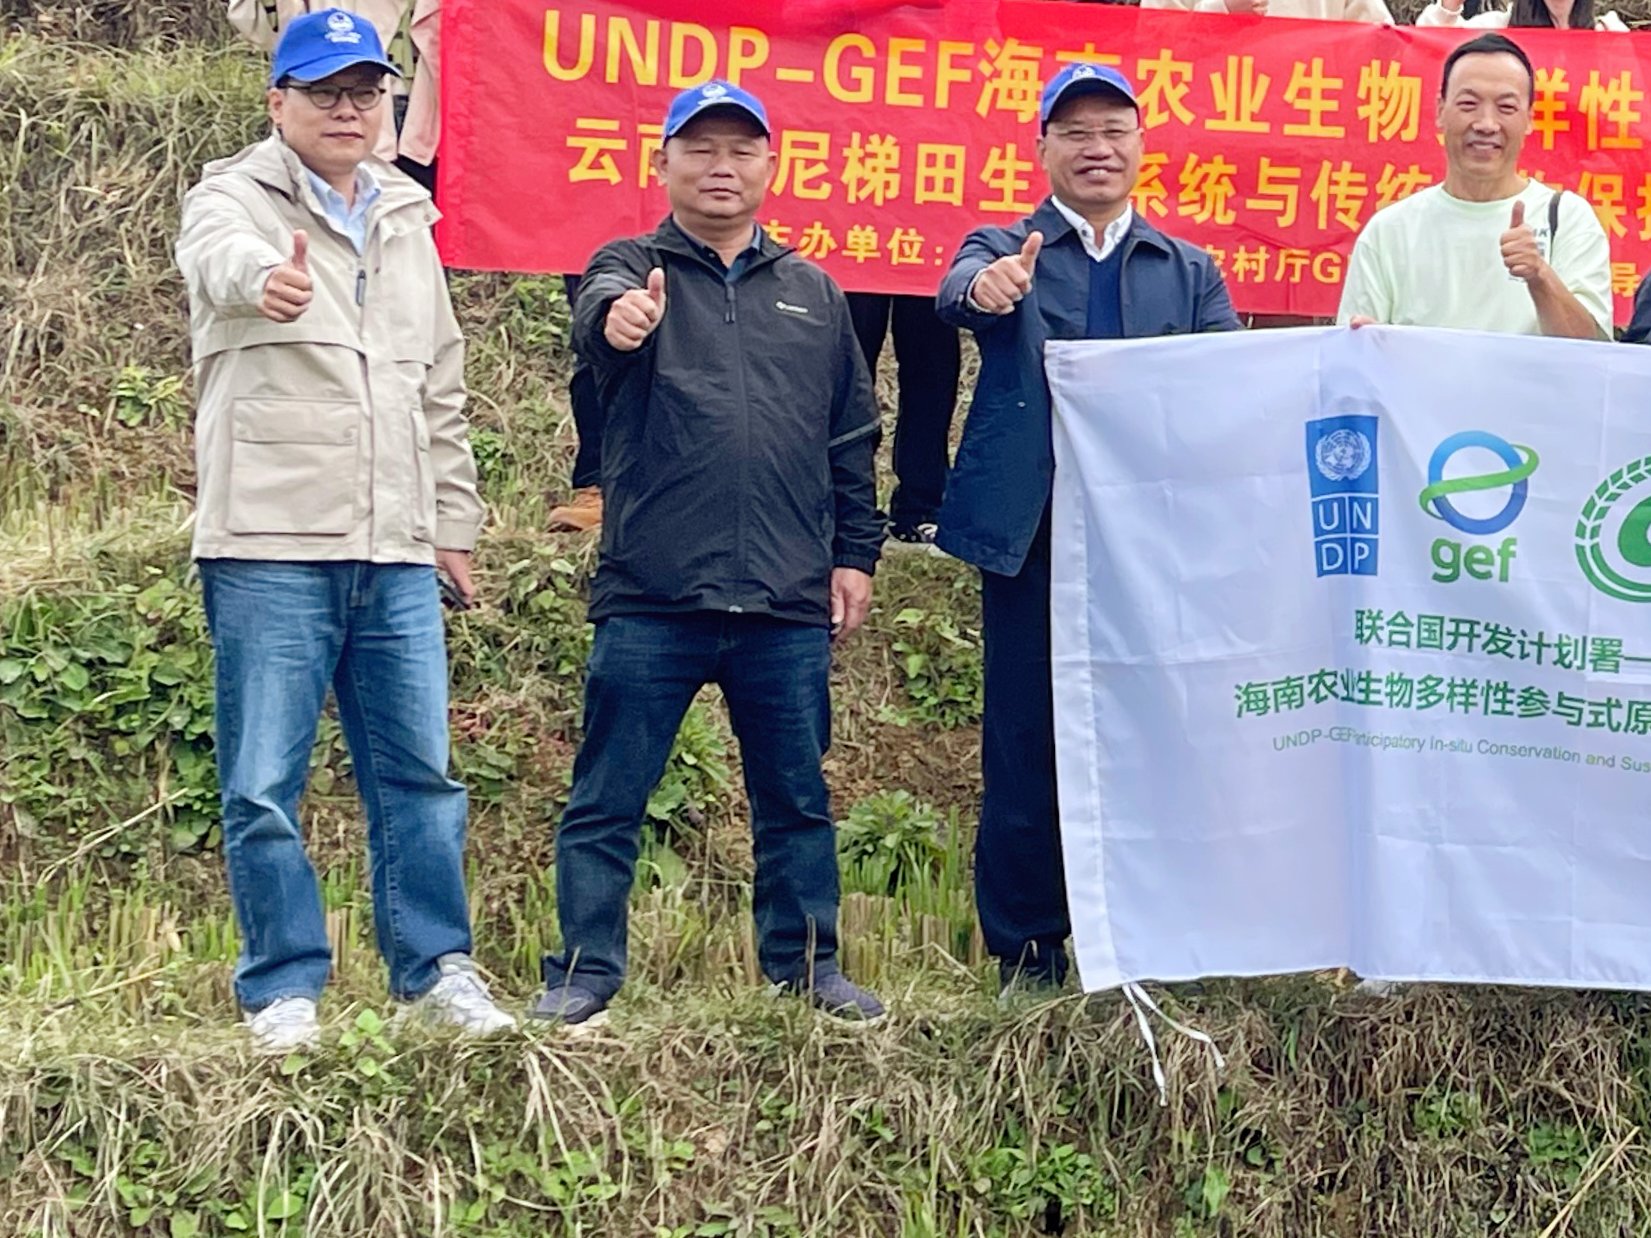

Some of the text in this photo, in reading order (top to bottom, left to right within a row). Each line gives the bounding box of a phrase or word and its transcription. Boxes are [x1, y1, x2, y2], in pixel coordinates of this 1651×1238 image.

[1431, 537, 1518, 583] gef
[1477, 739, 1580, 763] Conservation
[1585, 753, 1616, 768] and
